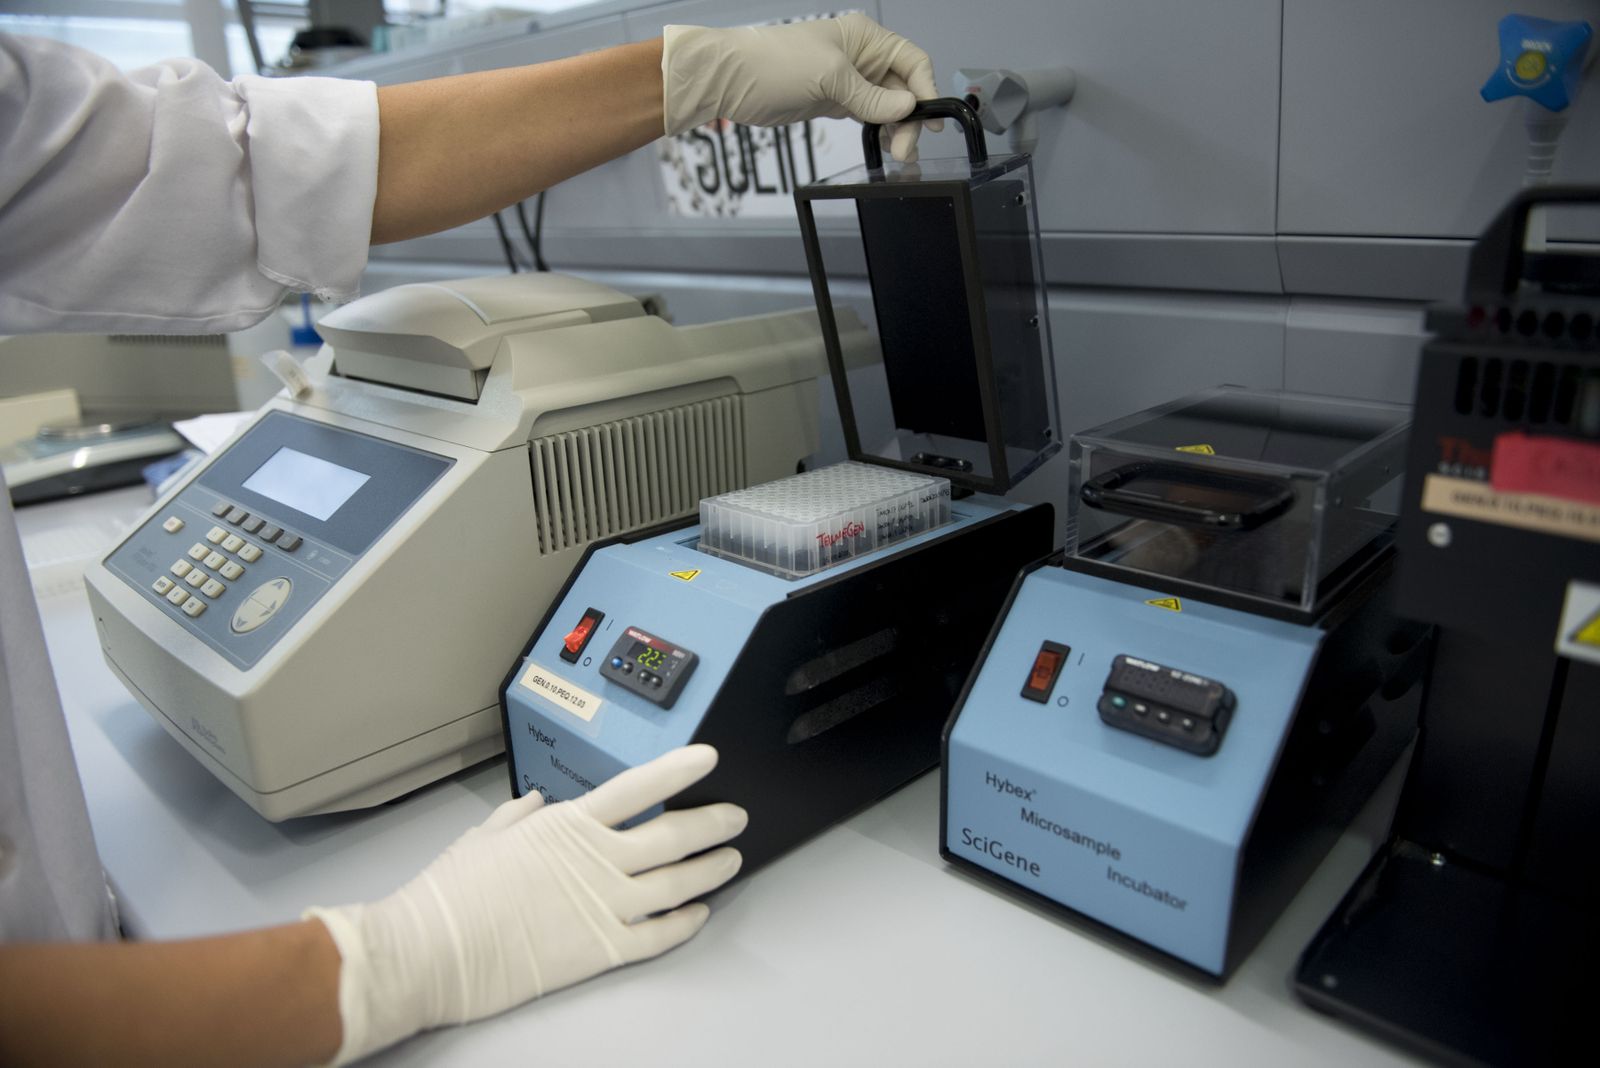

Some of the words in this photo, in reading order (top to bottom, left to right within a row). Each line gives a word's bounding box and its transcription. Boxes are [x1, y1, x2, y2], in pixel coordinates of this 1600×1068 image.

[550, 755, 597, 791] Microsam
[961, 827, 1041, 877] SciGene
[1020, 807, 1122, 861] Microsample
[1107, 865, 1188, 911] Incubator
